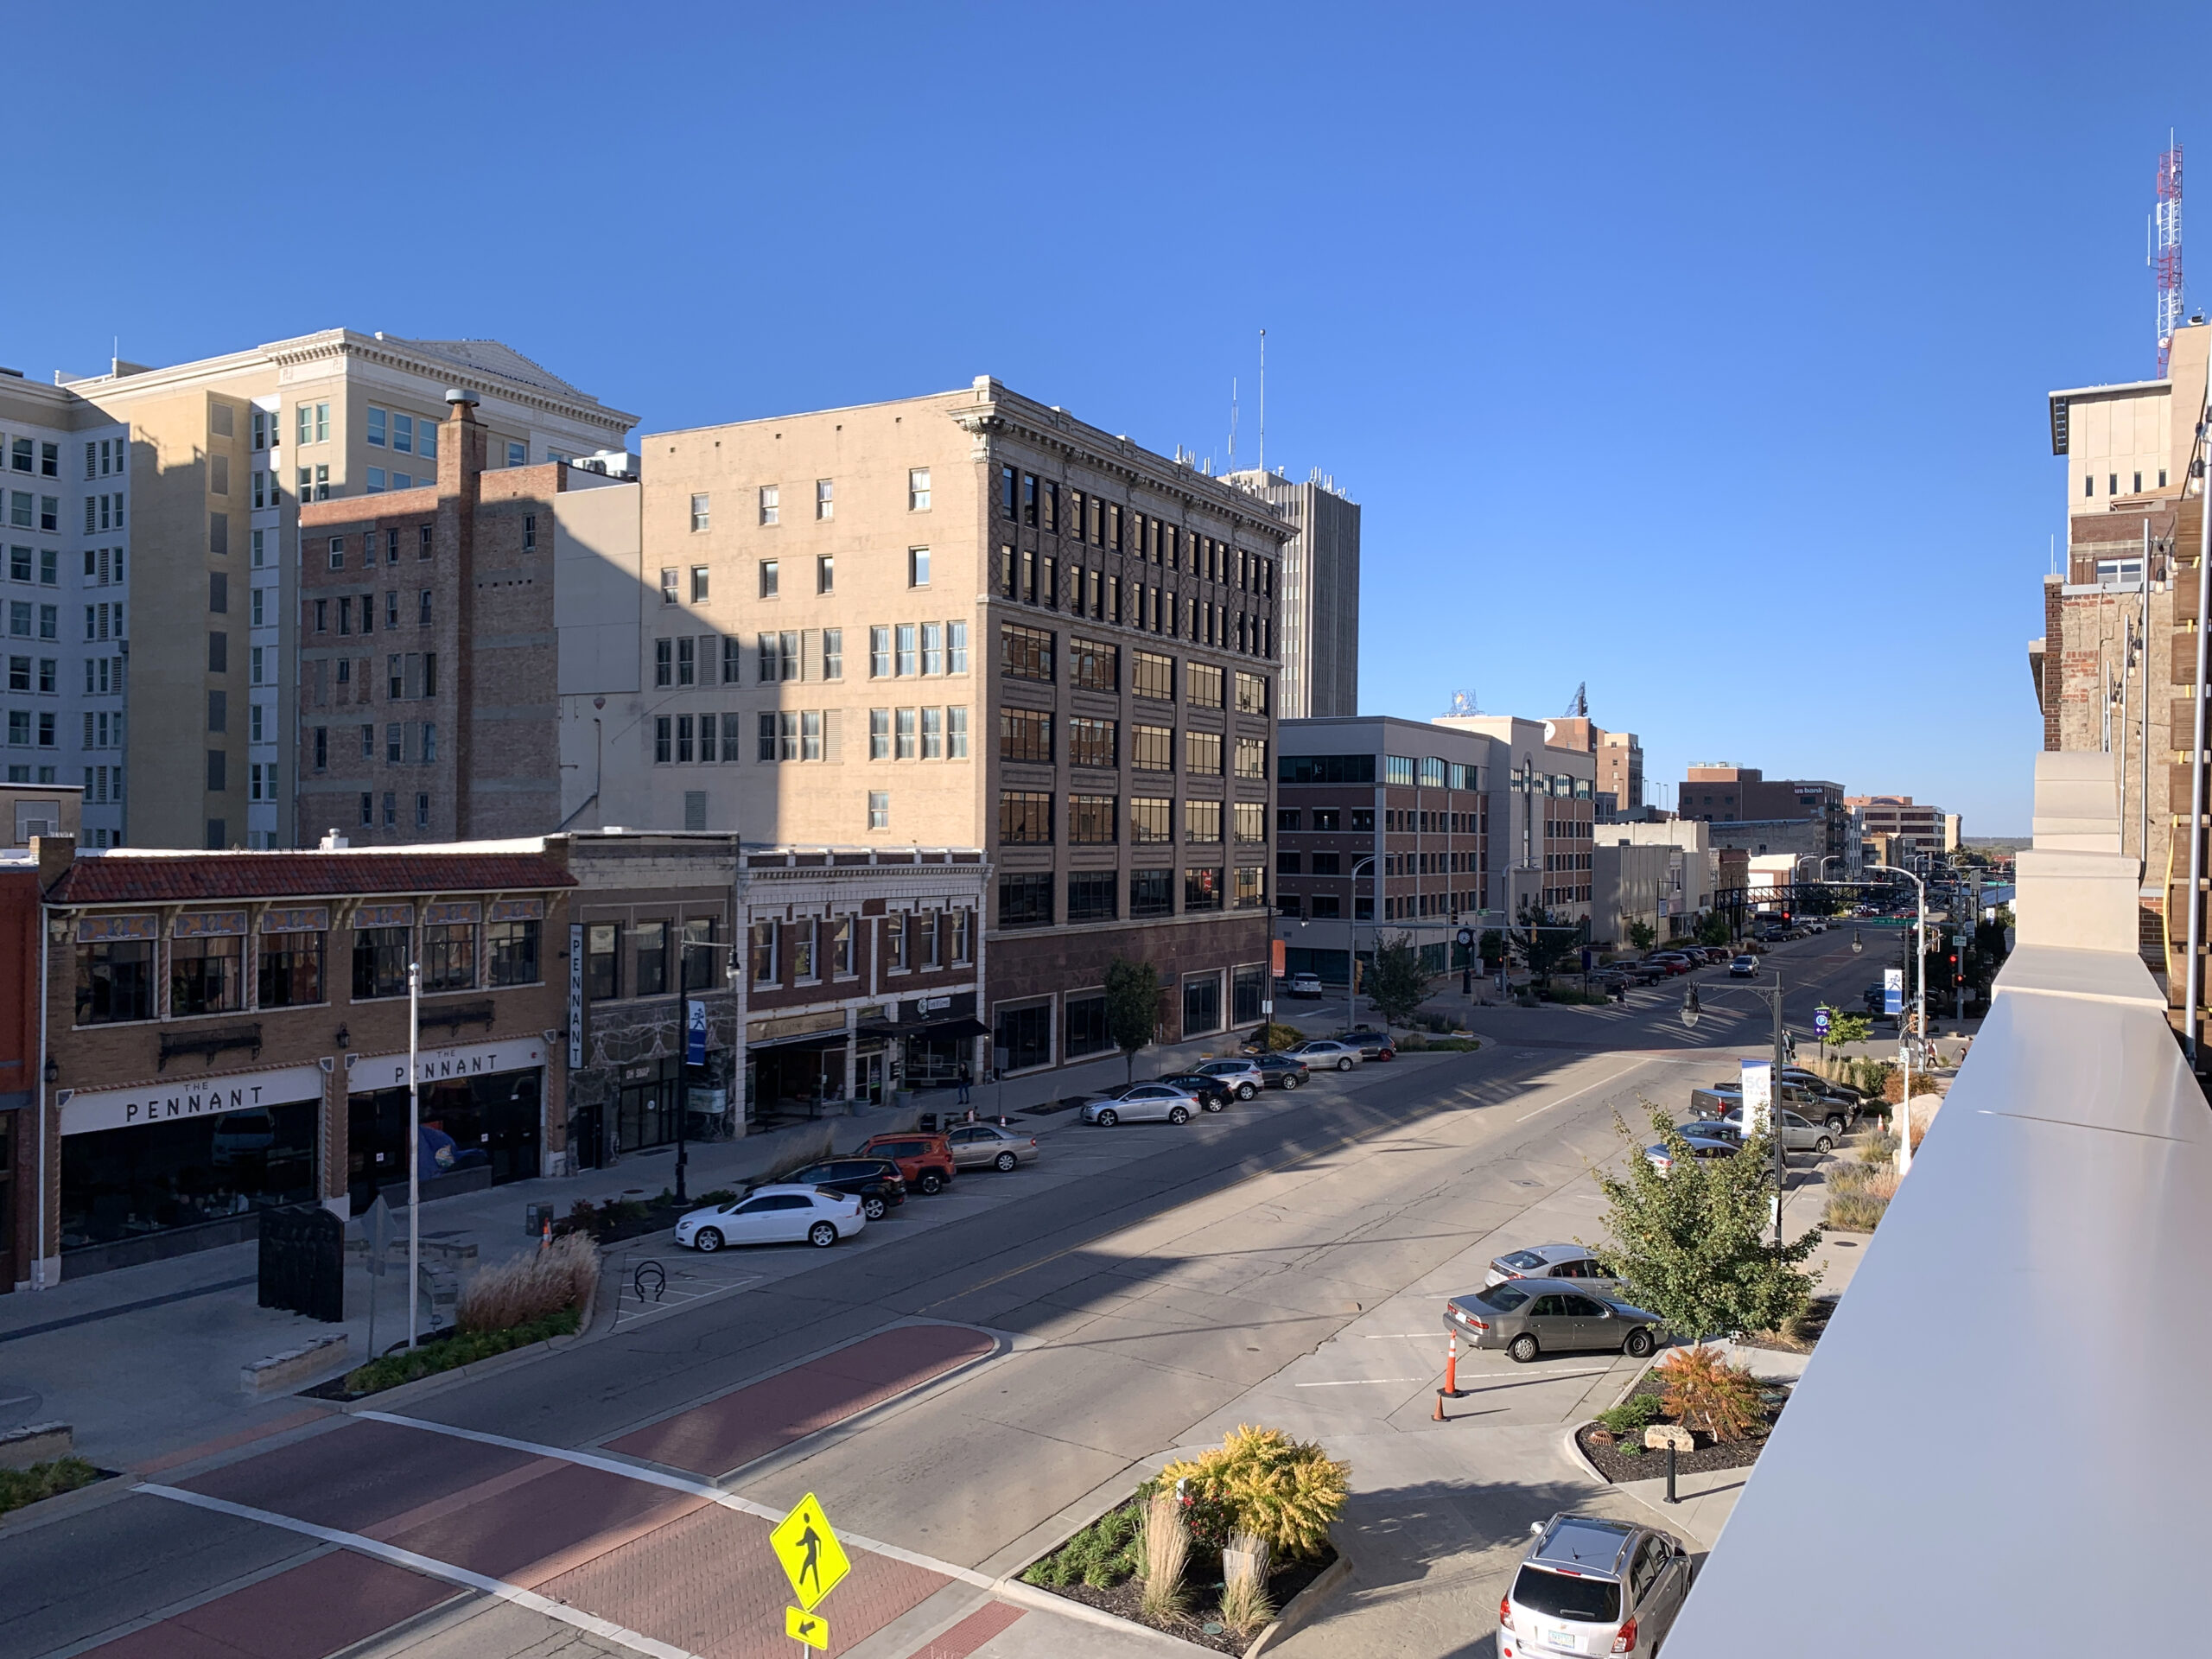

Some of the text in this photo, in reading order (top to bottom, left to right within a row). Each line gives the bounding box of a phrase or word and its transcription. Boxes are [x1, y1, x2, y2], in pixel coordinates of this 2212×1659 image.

[572, 939, 581, 1062] PENNANT
[436, 1049, 455, 1058] THE
[395, 1054, 497, 1083] PNNANT
[184, 1081, 209, 1092] THE
[126, 1086, 263, 1122] PENNANT
